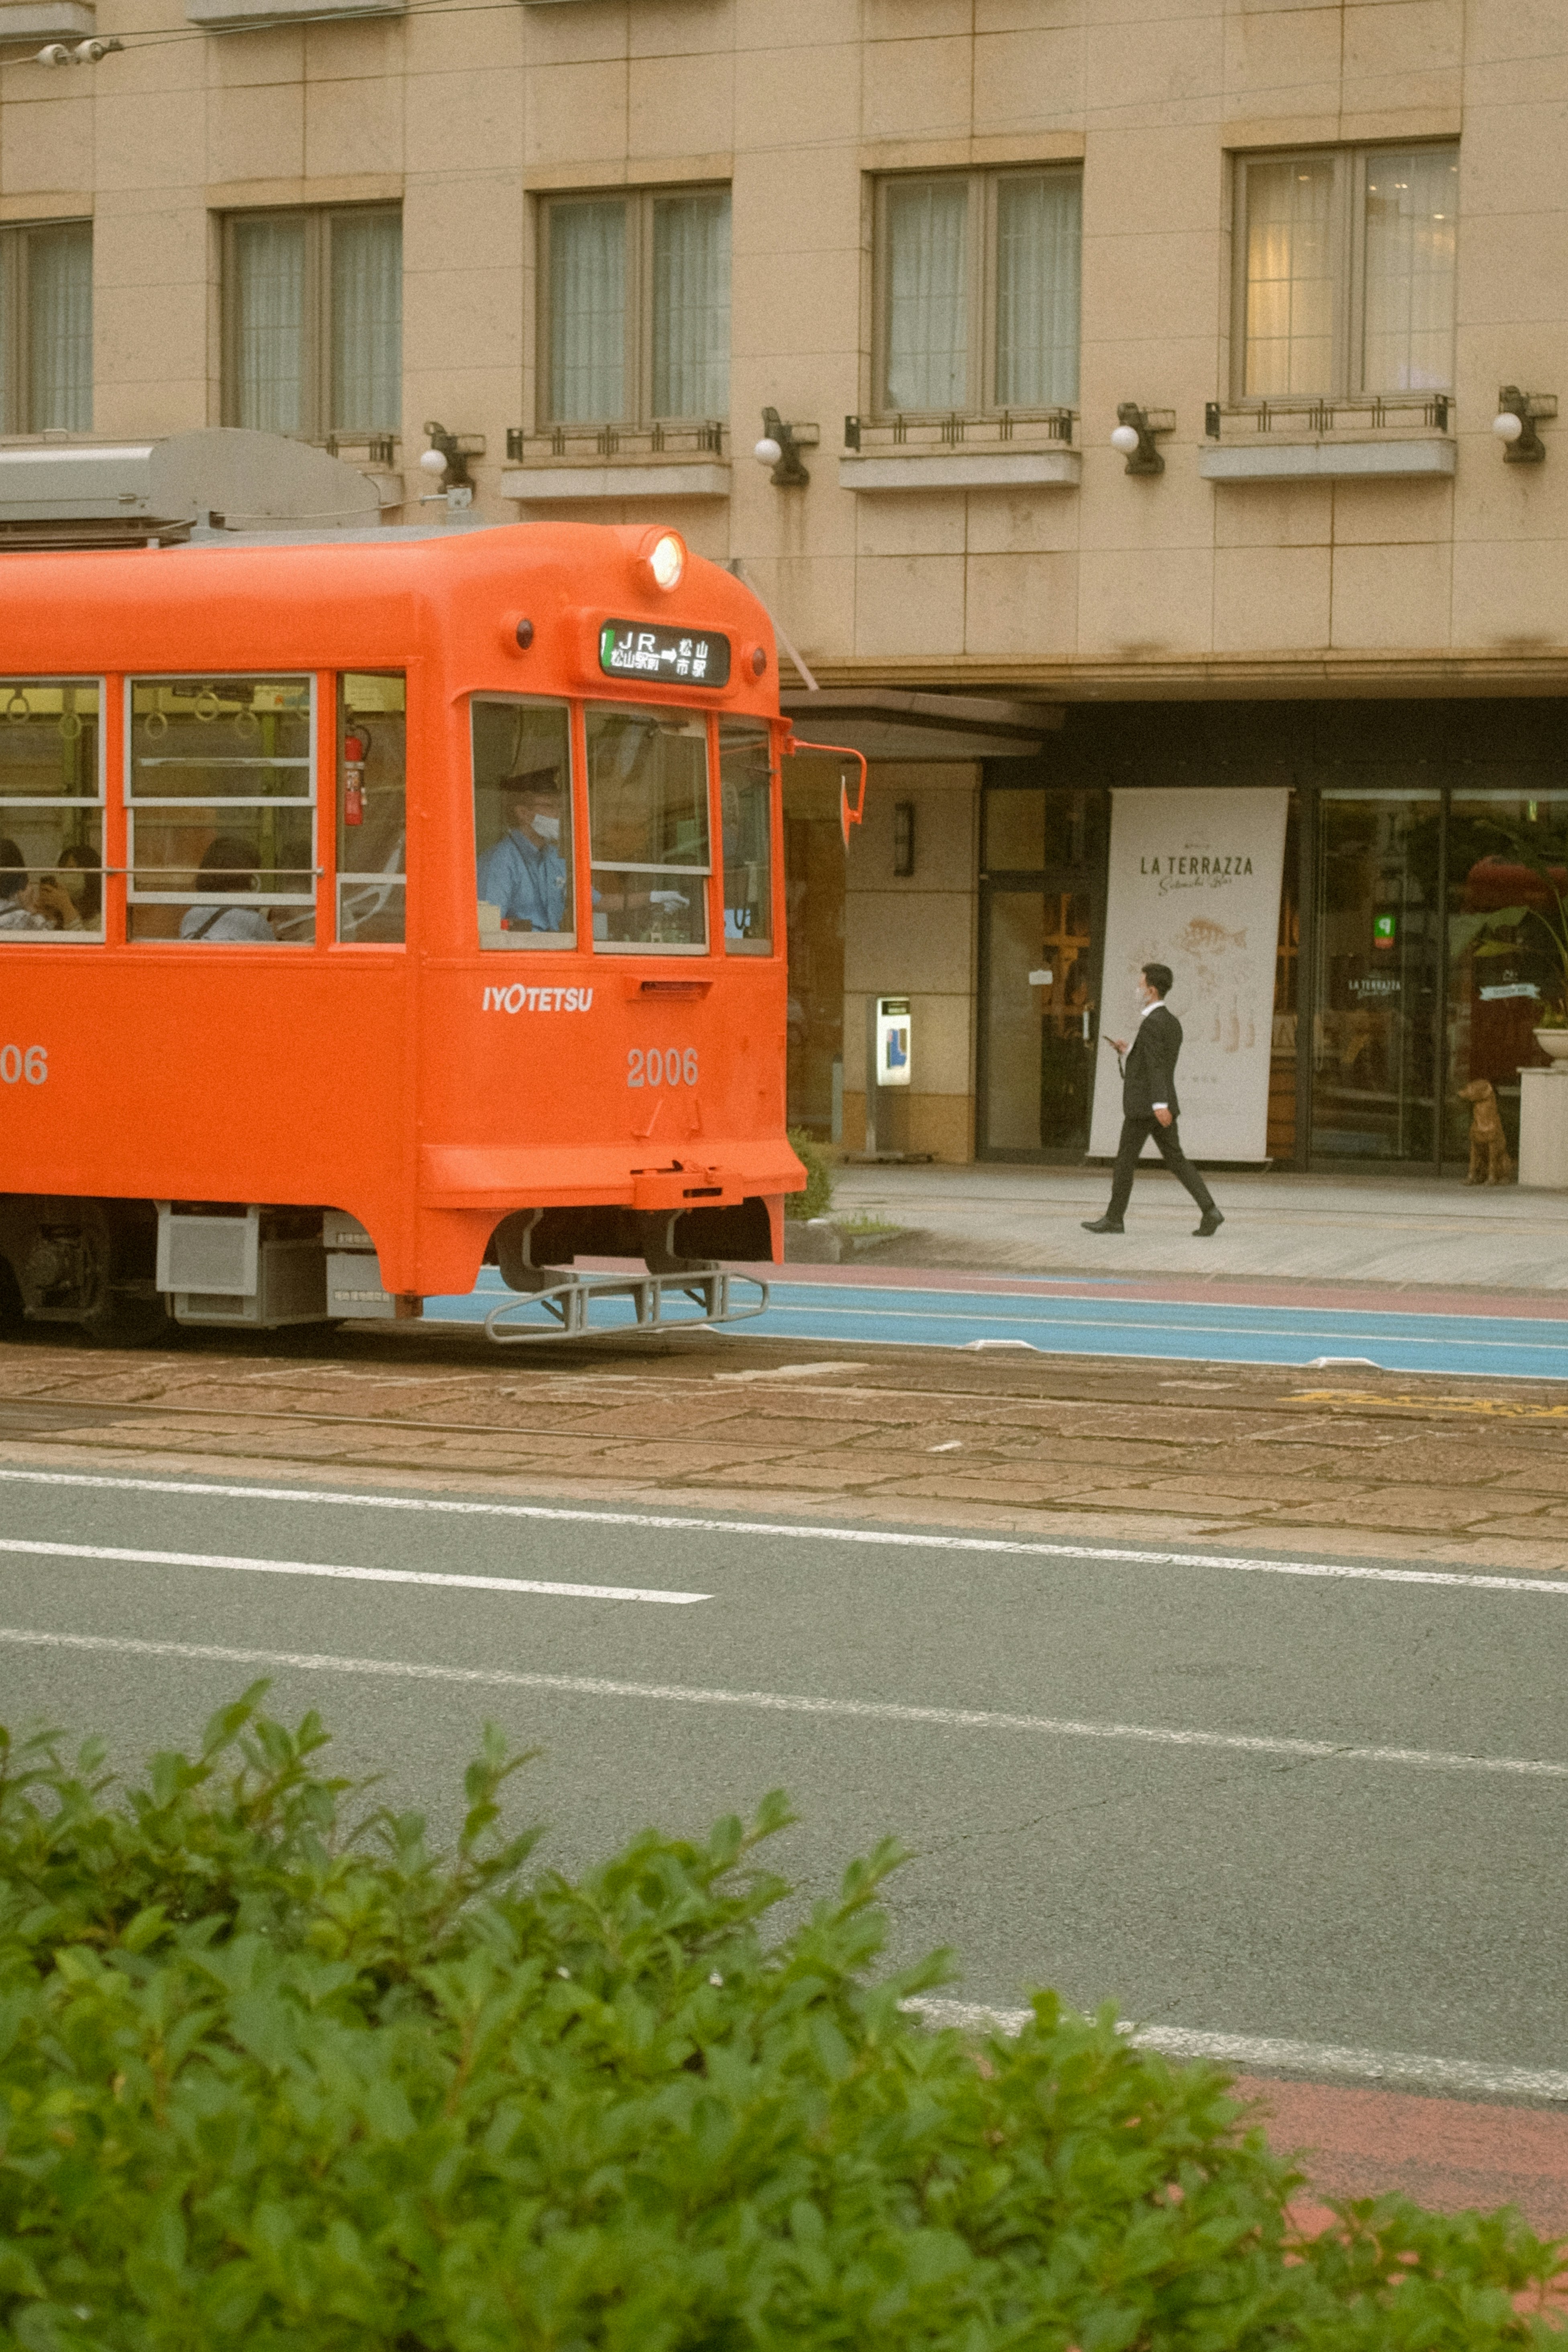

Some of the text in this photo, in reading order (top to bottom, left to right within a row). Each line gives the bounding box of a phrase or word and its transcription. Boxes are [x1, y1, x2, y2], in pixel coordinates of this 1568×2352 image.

[618, 631, 655, 652] JR
[679, 638, 708, 659] 松山
[1141, 857, 1253, 875] LA TERRAZZA
[483, 983, 593, 1014] IYOTETSU
[627, 1048, 699, 1087] 2006
